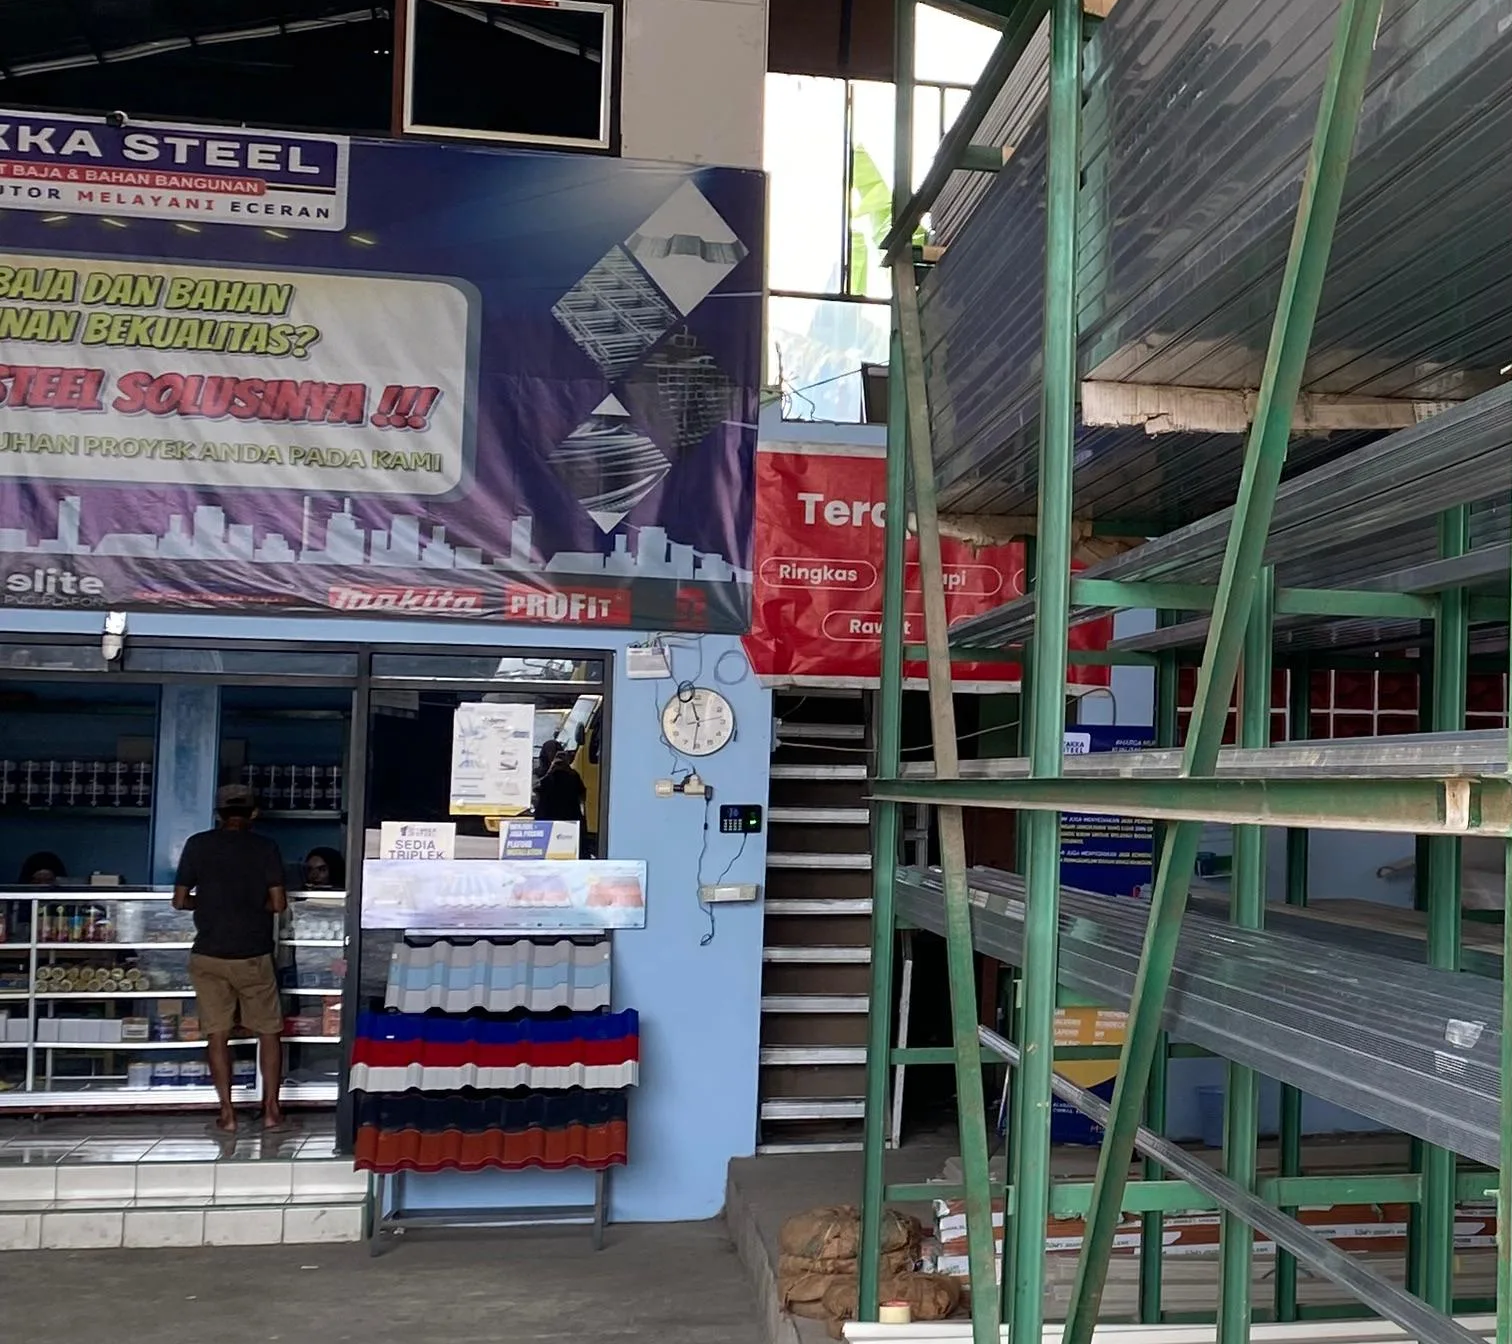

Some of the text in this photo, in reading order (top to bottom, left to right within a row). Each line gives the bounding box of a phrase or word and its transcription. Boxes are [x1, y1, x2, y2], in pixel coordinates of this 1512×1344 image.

[122, 133, 321, 175] STEEL
[13, 165, 62, 180] BAJA
[68, 169, 79, 181] &
[85, 170, 150, 186] BAHAN
[155, 174, 258, 193] BANGUNAN
[77, 191, 215, 211] MELAYANI
[230, 201, 330, 219] ECERAN
[81, 272, 163, 306] DAN
[164, 277, 293, 314] BAHAN
[0, 307, 320, 359] NAN BEKUALITAS?
[112, 371, 370, 426] SOLUSINYA
[370, 385, 441, 430] !!!
[84, 434, 196, 459] PROYEK
[201, 442, 283, 465] ANDA
[289, 447, 366, 469] PADA
[371, 451, 442, 474] KAMI
[779, 562, 858, 584] Ringkas
[511, 592, 612, 622] PROFIT
[849, 619, 911, 635] Rawt
[388, 850, 445, 860] TRIPLEK
[395, 840, 436, 850] SEDIA
